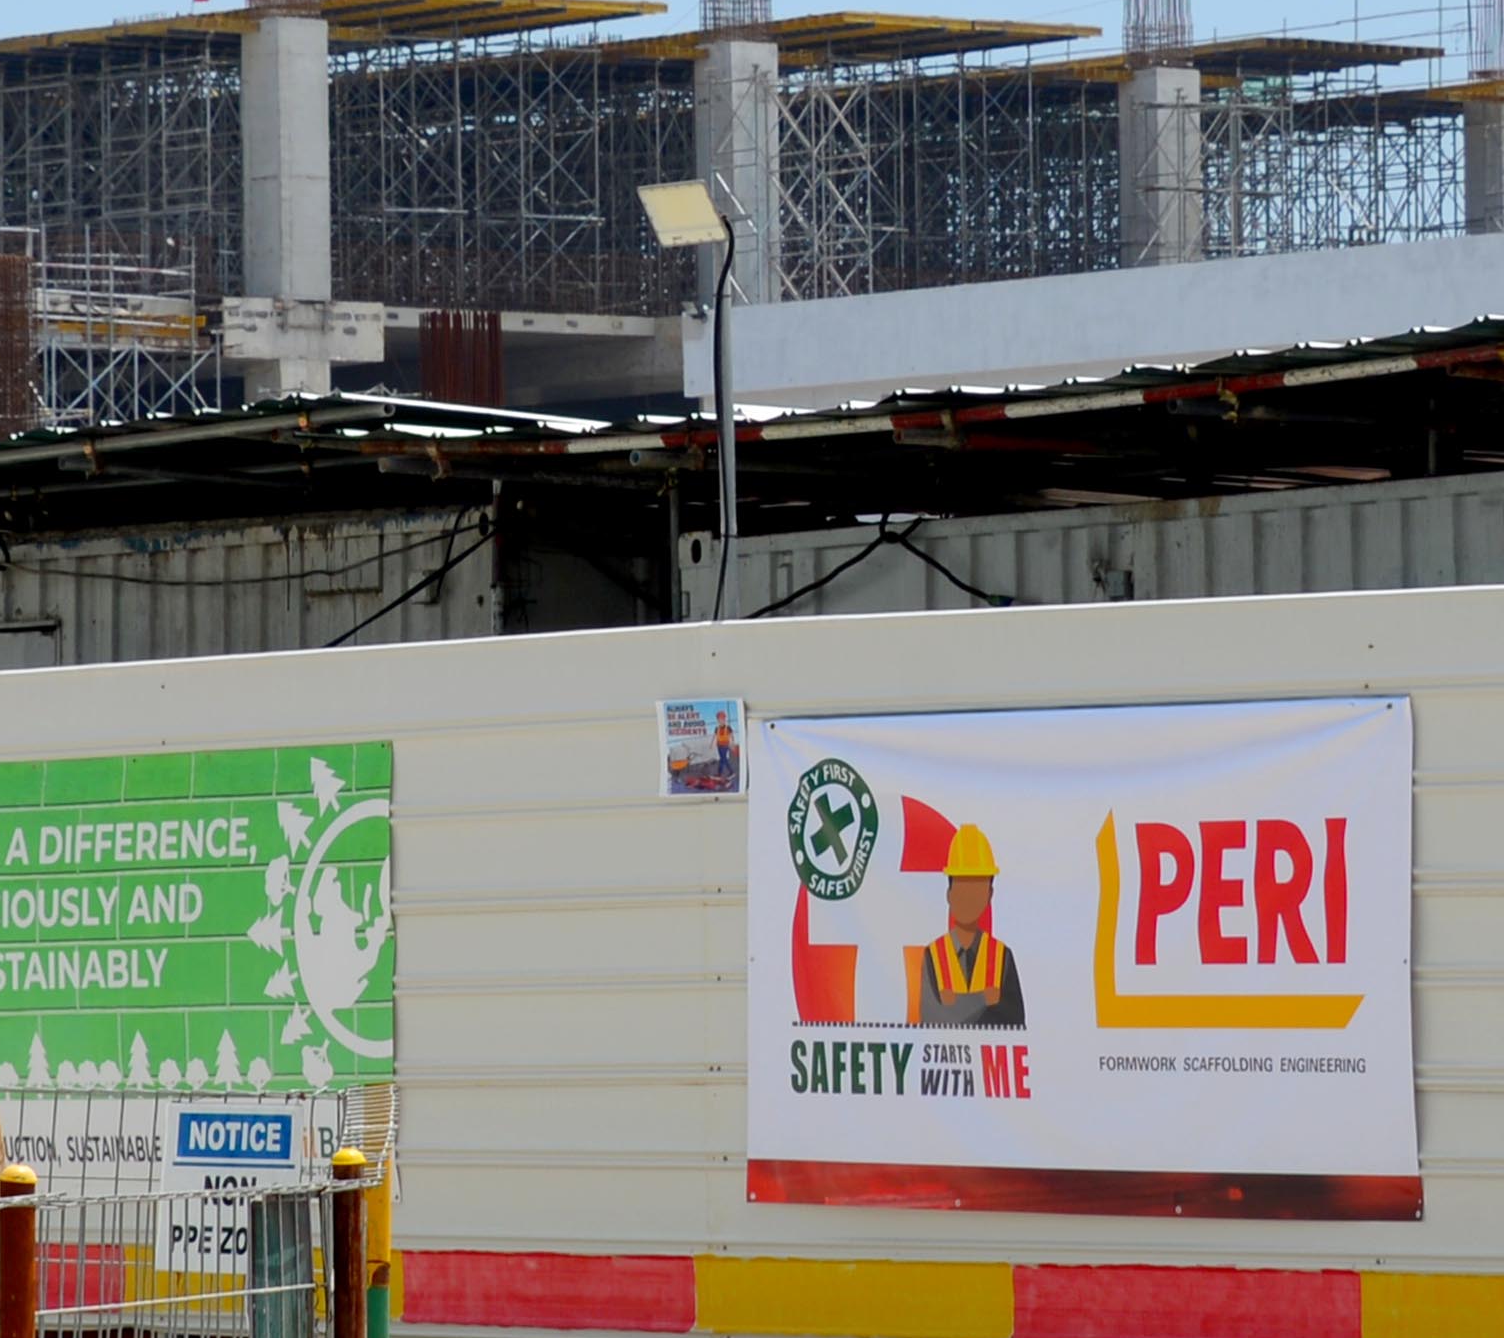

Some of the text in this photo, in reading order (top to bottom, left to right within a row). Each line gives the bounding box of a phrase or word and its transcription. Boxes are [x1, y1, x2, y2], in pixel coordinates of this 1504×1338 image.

[790, 764, 856, 835] SAFETY FIRST
[5, 827, 29, 866] A
[39, 816, 258, 865] DIFFERENCE,
[808, 828, 875, 897] SAFETY FIRST
[127, 883, 203, 925] AND
[1135, 817, 1347, 965] PERI
[790, 1039, 1032, 1099] SAFETY STARTS WITH ME
[1099, 1055, 1367, 1074] FORMWORK SCAFFOLDING ENGINEERING
[3, 1135, 162, 1168] UCTION, SUSTAINABLE
[189, 1120, 282, 1153] NOTICE
[204, 1174, 257, 1207] NON
[171, 1225, 248, 1255] PPE ZO
